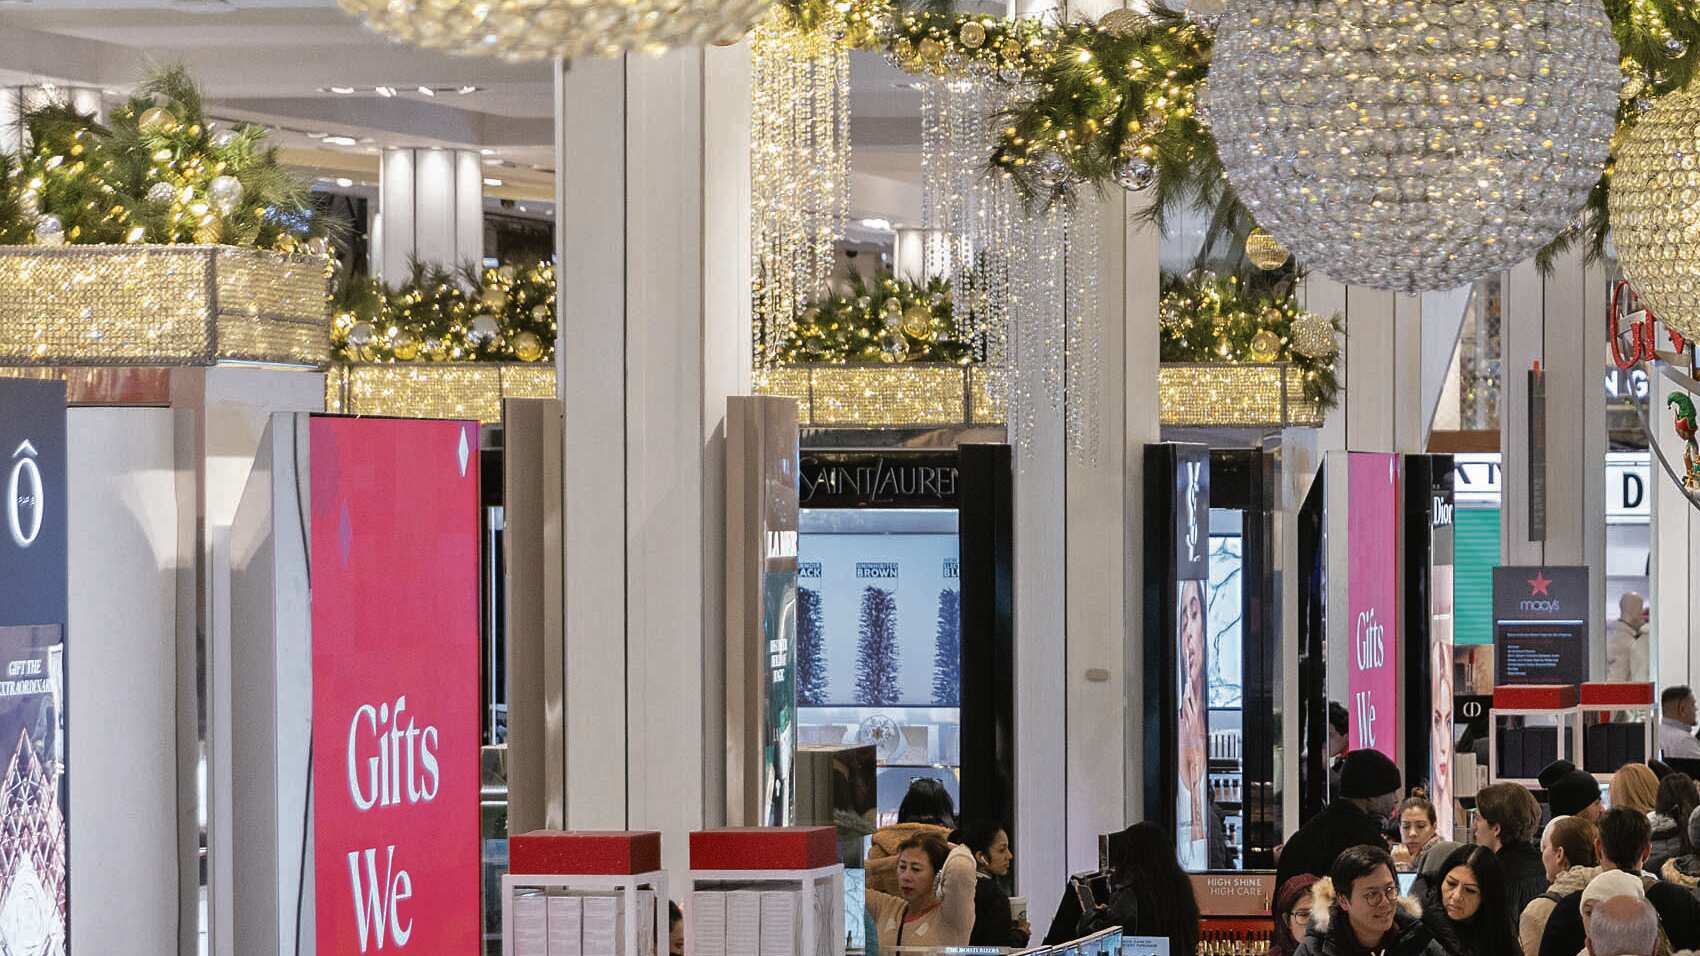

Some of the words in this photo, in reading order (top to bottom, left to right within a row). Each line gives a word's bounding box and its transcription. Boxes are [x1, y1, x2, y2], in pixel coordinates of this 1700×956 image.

[1433, 496, 1453, 524] Dior
[857, 568, 898, 577] BROWN
[1357, 608, 1384, 671] Gifts
[1356, 690, 1376, 750] We
[348, 695, 440, 812] Gifts
[348, 845, 413, 953] We
[1208, 878, 1231, 886] HIGH
[1234, 878, 1262, 887] SHINE
[1210, 887, 1234, 896] HIGH
[1237, 887, 1262, 896] CARE
